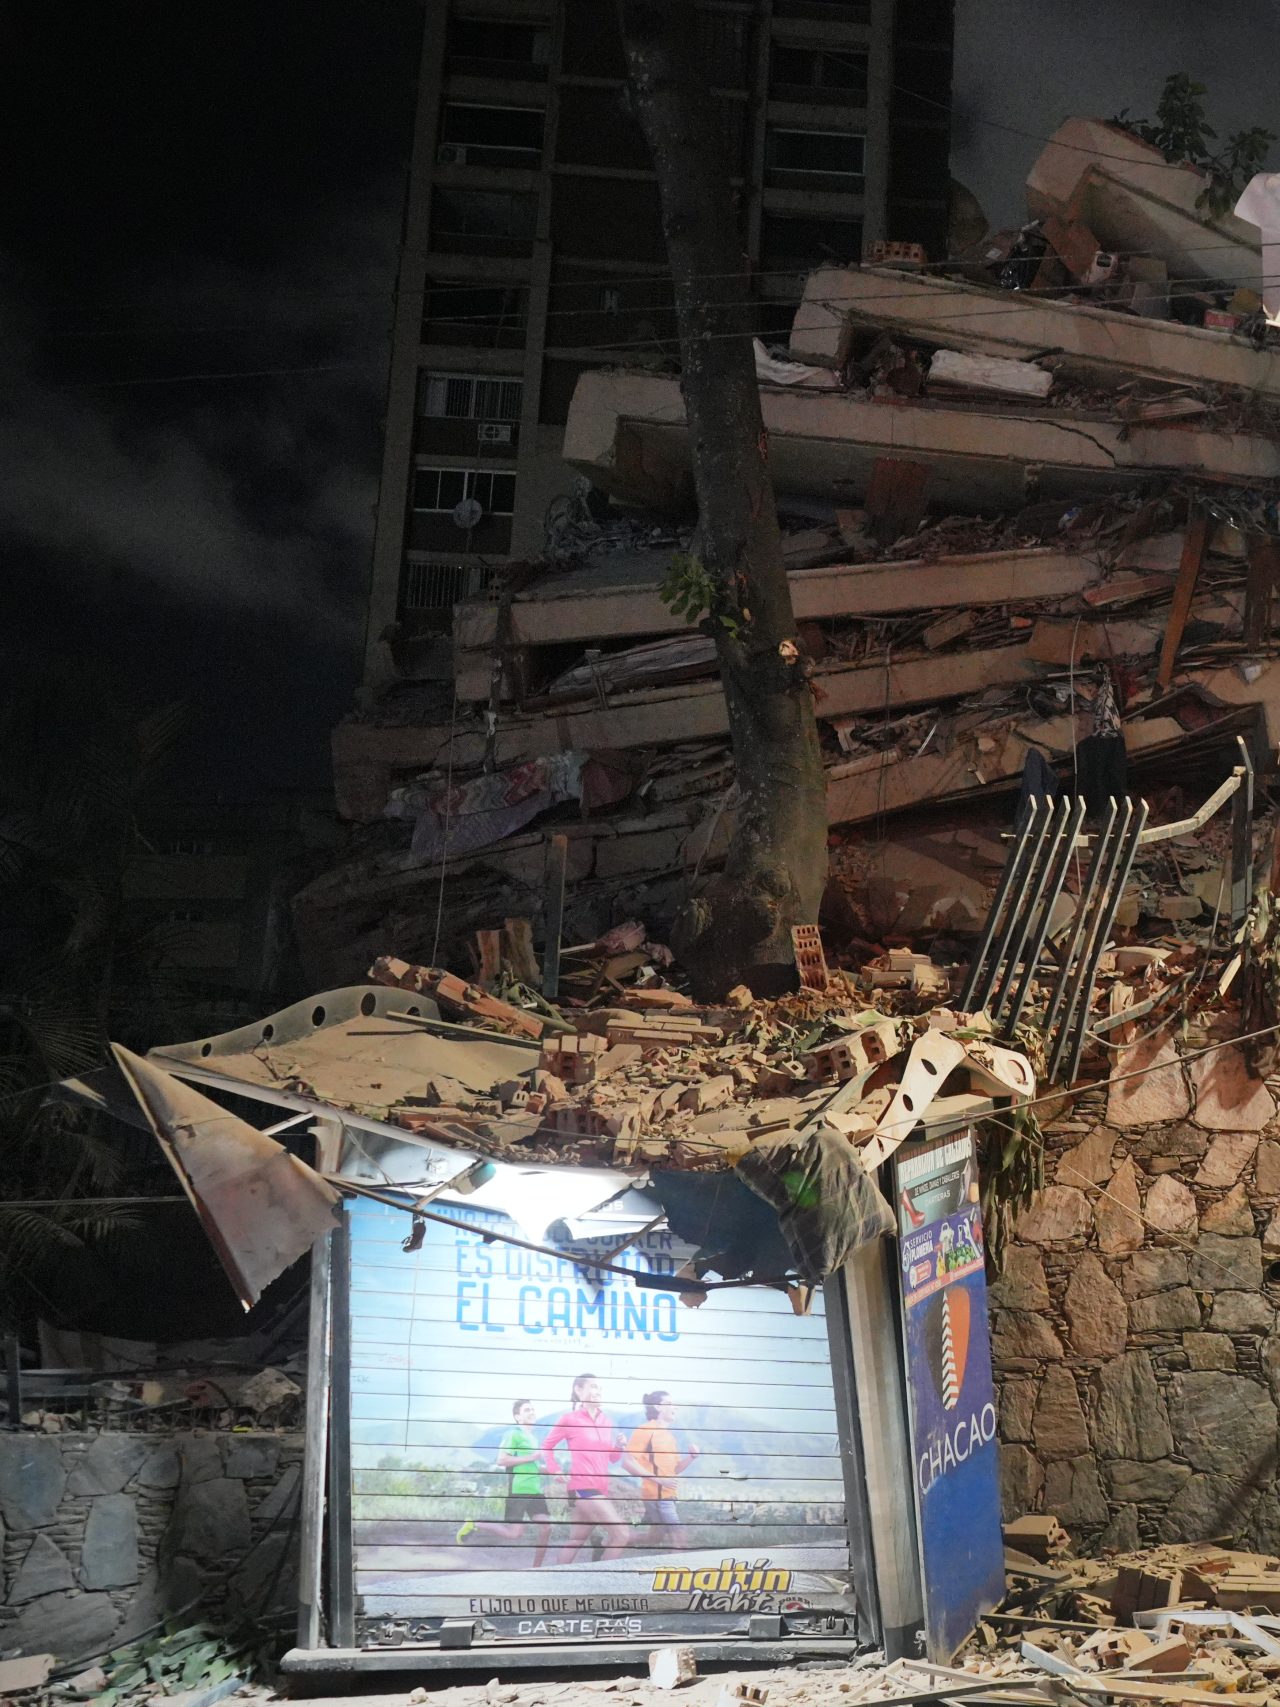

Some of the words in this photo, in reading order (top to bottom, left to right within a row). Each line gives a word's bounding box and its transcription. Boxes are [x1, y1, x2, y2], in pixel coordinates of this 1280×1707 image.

[910, 1230, 933, 1249] SERVICIO
[455, 1239, 493, 1279] ES
[456, 1281, 505, 1332] EL
[518, 1285, 680, 1342] CAMINO
[920, 1403, 995, 1494] CHACAO
[652, 1558, 793, 1592] maltín
[470, 1598, 512, 1613] ELIJO
[518, 1598, 536, 1612] LO
[541, 1598, 570, 1612] QUE
[575, 1598, 595, 1611] ME
[601, 1597, 649, 1611] GUSTA
